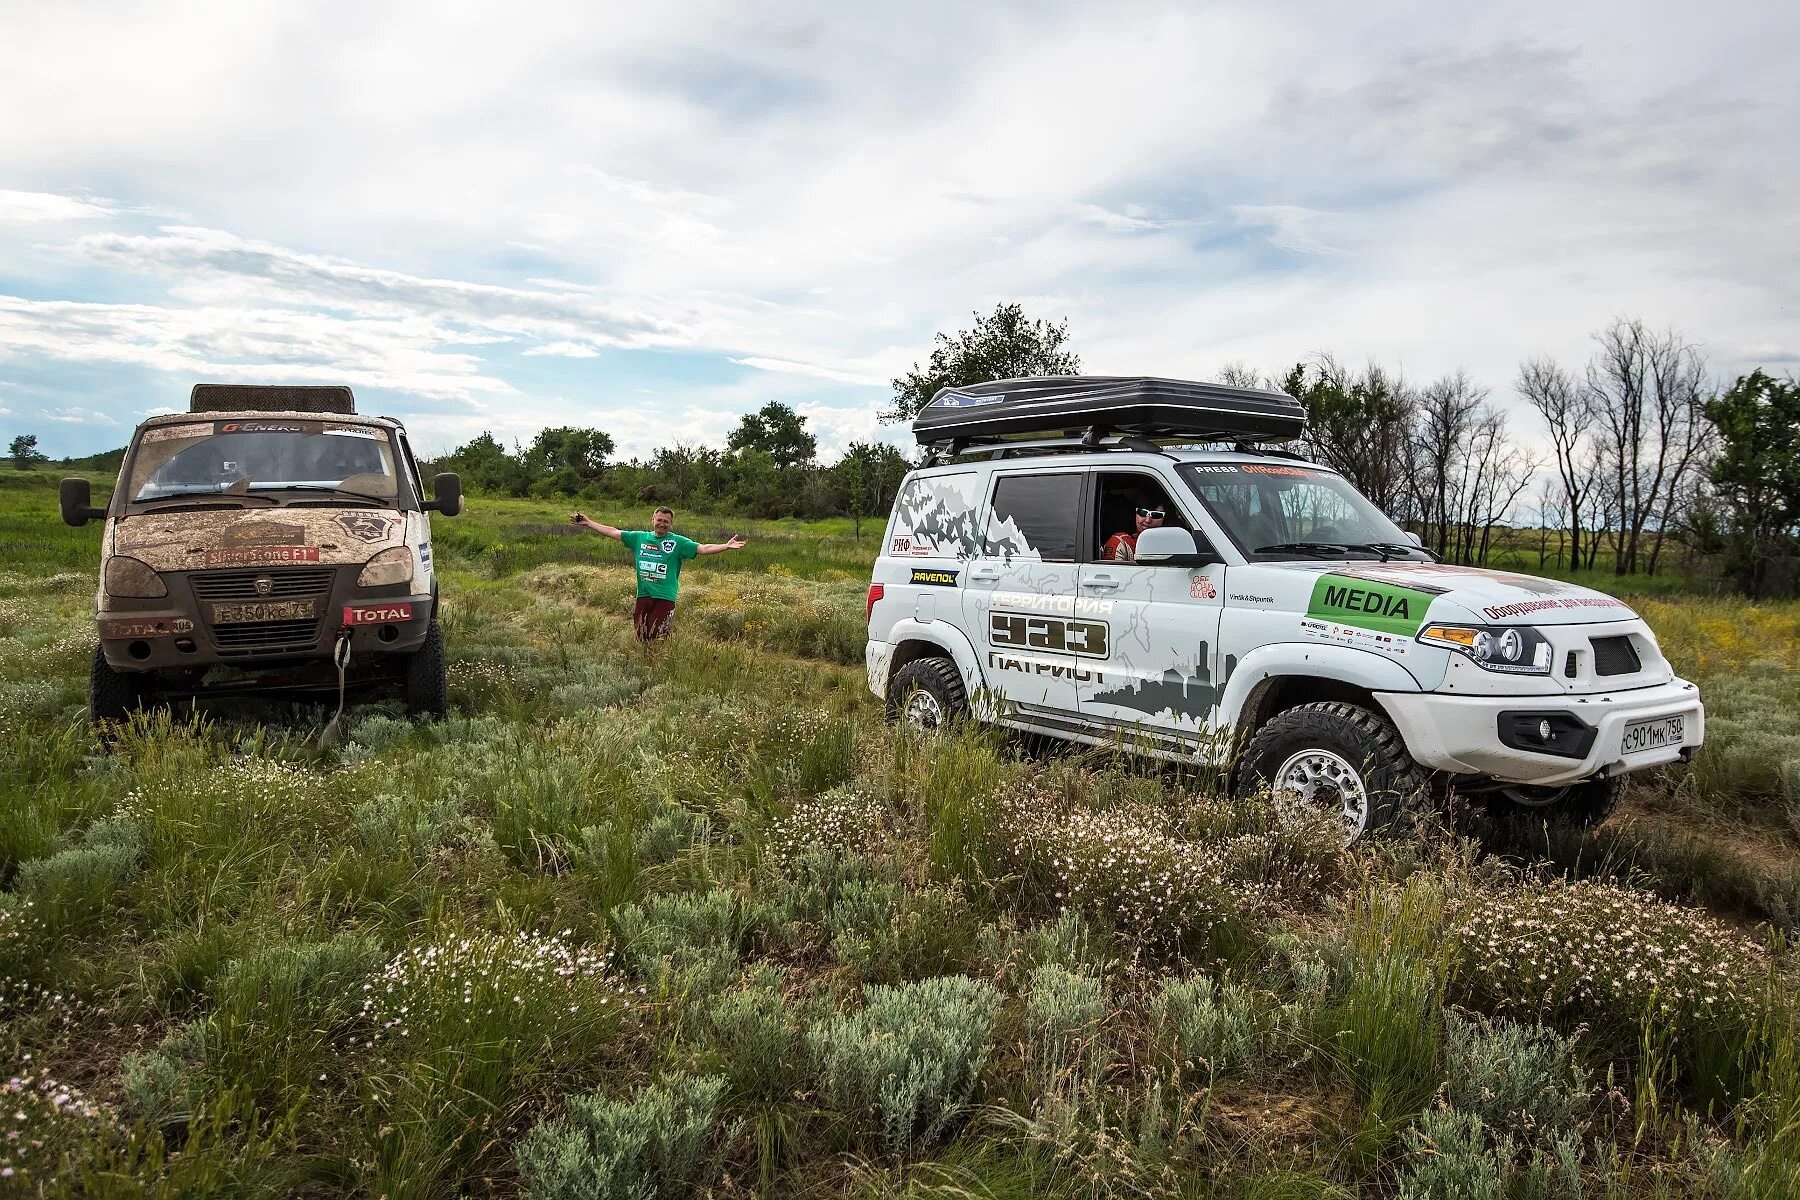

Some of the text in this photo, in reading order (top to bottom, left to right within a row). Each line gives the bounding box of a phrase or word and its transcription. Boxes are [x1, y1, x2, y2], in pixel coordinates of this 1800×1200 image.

[222, 422, 307, 433] G-ENERG
[892, 538, 911, 552] РИФ
[913, 572, 955, 584] RAVENOL
[1323, 586, 1409, 619] MEDIA
[351, 608, 410, 622] TOTAL
[988, 651, 1106, 684] ПАТРИОТ
[1667, 718, 1681, 736] 750
